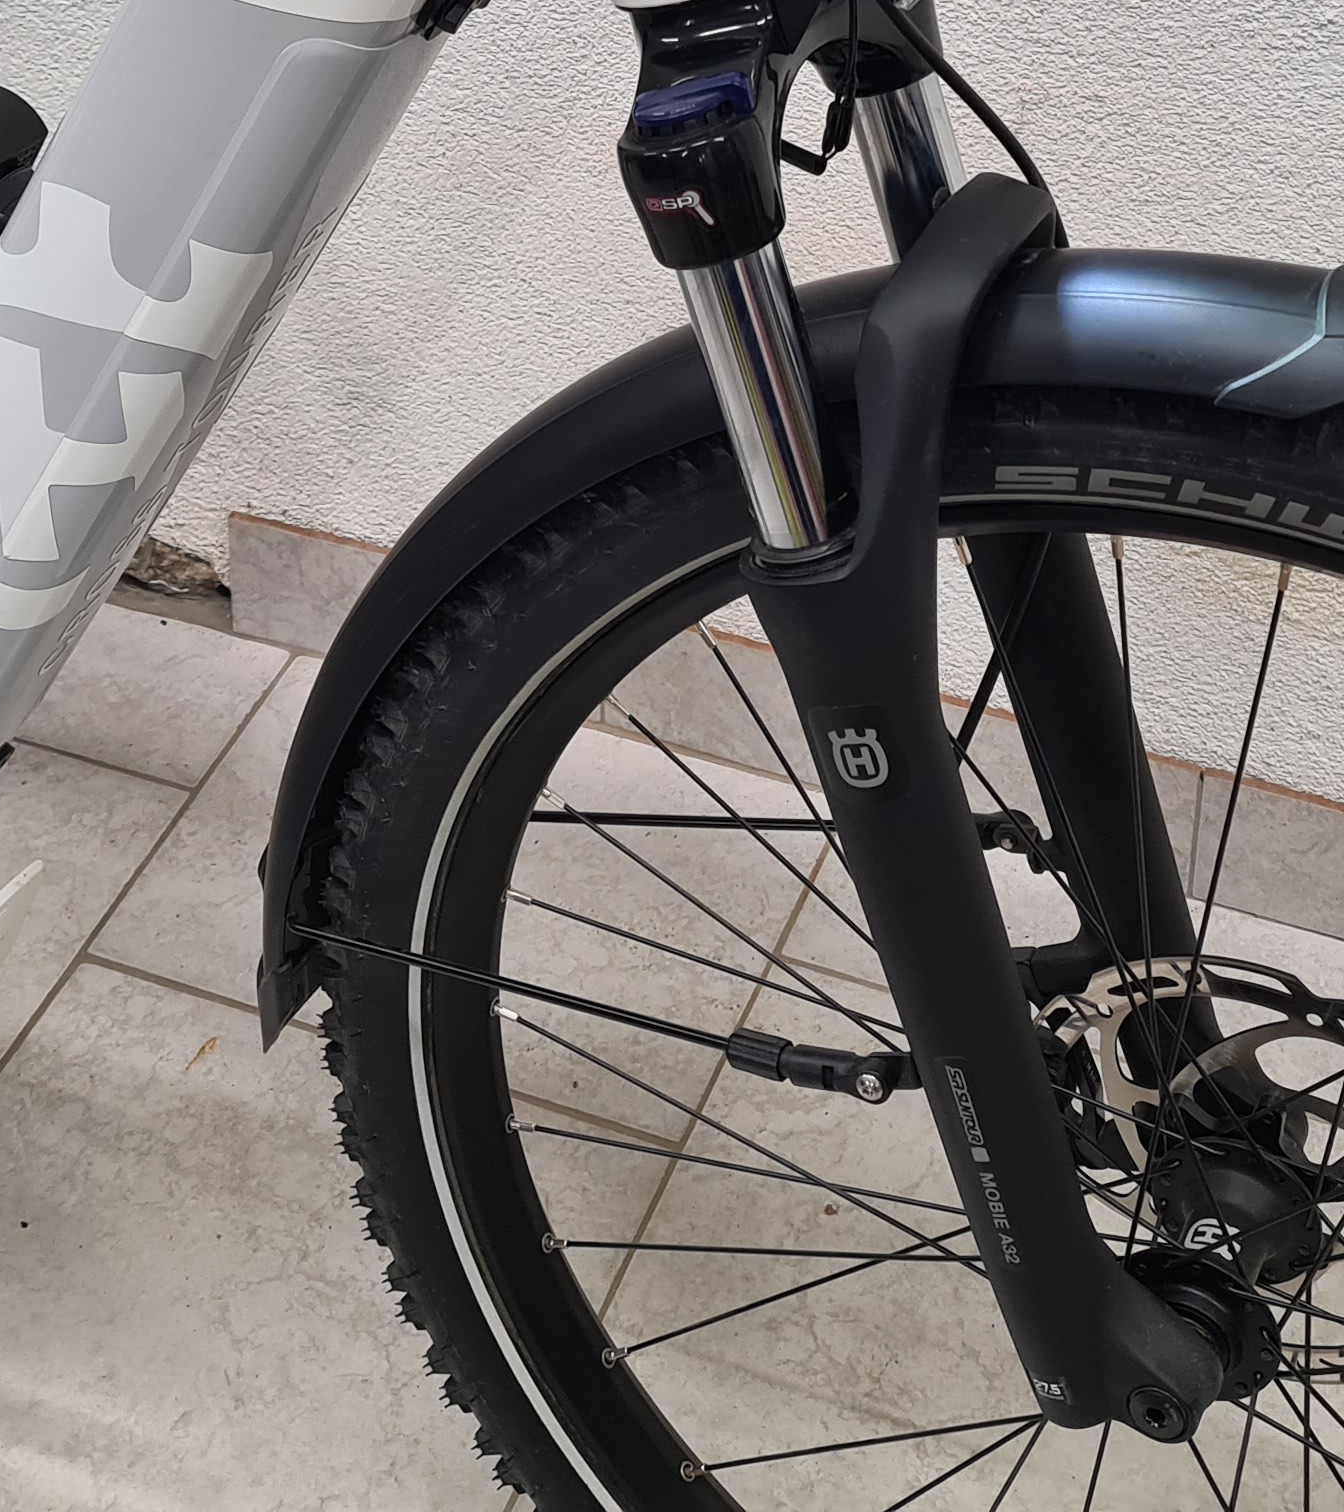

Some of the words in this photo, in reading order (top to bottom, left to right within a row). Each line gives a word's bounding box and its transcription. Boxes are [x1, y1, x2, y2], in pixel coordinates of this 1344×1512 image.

[37, 484, 169, 677] CROSS
[163, 206, 340, 473] TOURER
[980, 1171, 1011, 1230] MOBIE
[998, 1232, 1021, 1264] A32
[1033, 1378, 1062, 1395] 27.5
